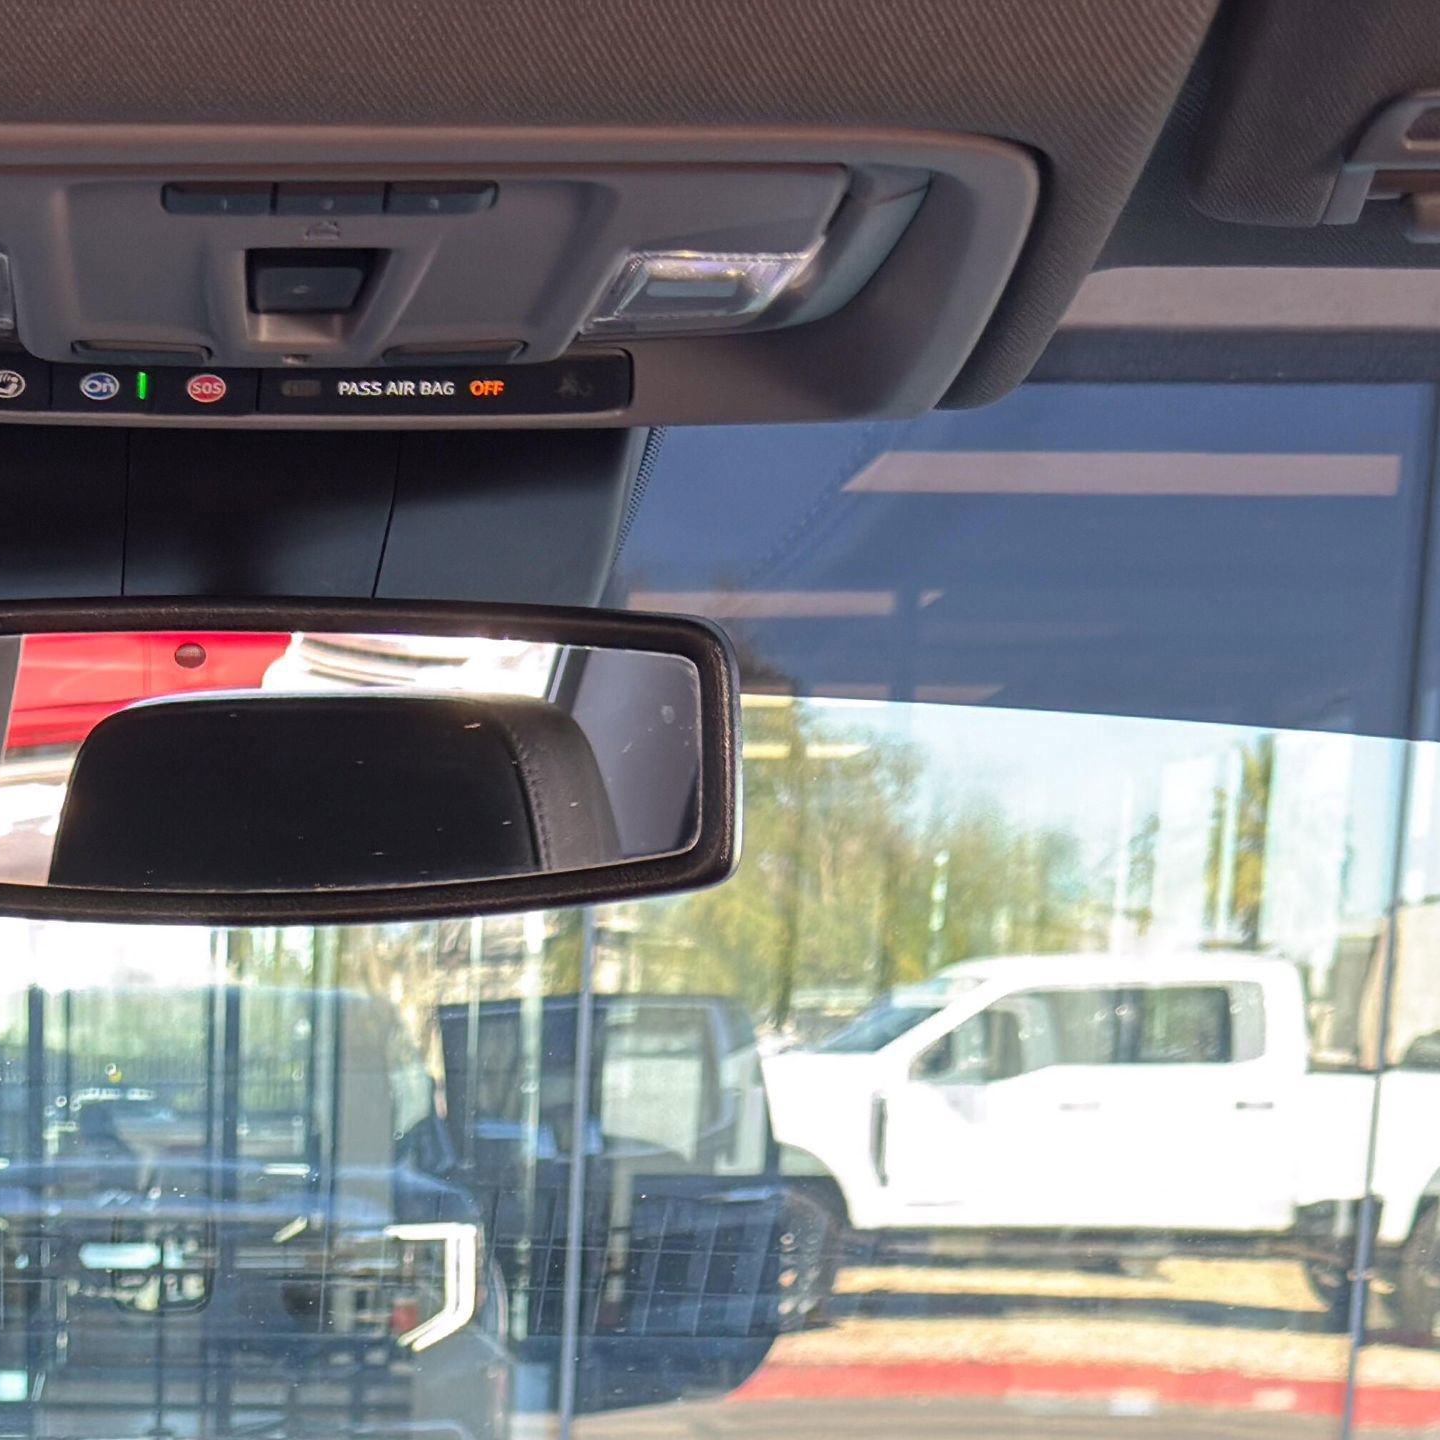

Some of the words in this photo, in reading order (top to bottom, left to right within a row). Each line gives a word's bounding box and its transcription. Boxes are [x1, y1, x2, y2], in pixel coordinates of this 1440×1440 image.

[191, 381, 223, 395] SOS
[338, 381, 383, 396] PASS
[386, 381, 416, 396] AIR
[419, 381, 455, 396] BAG
[469, 380, 504, 397] OFF
